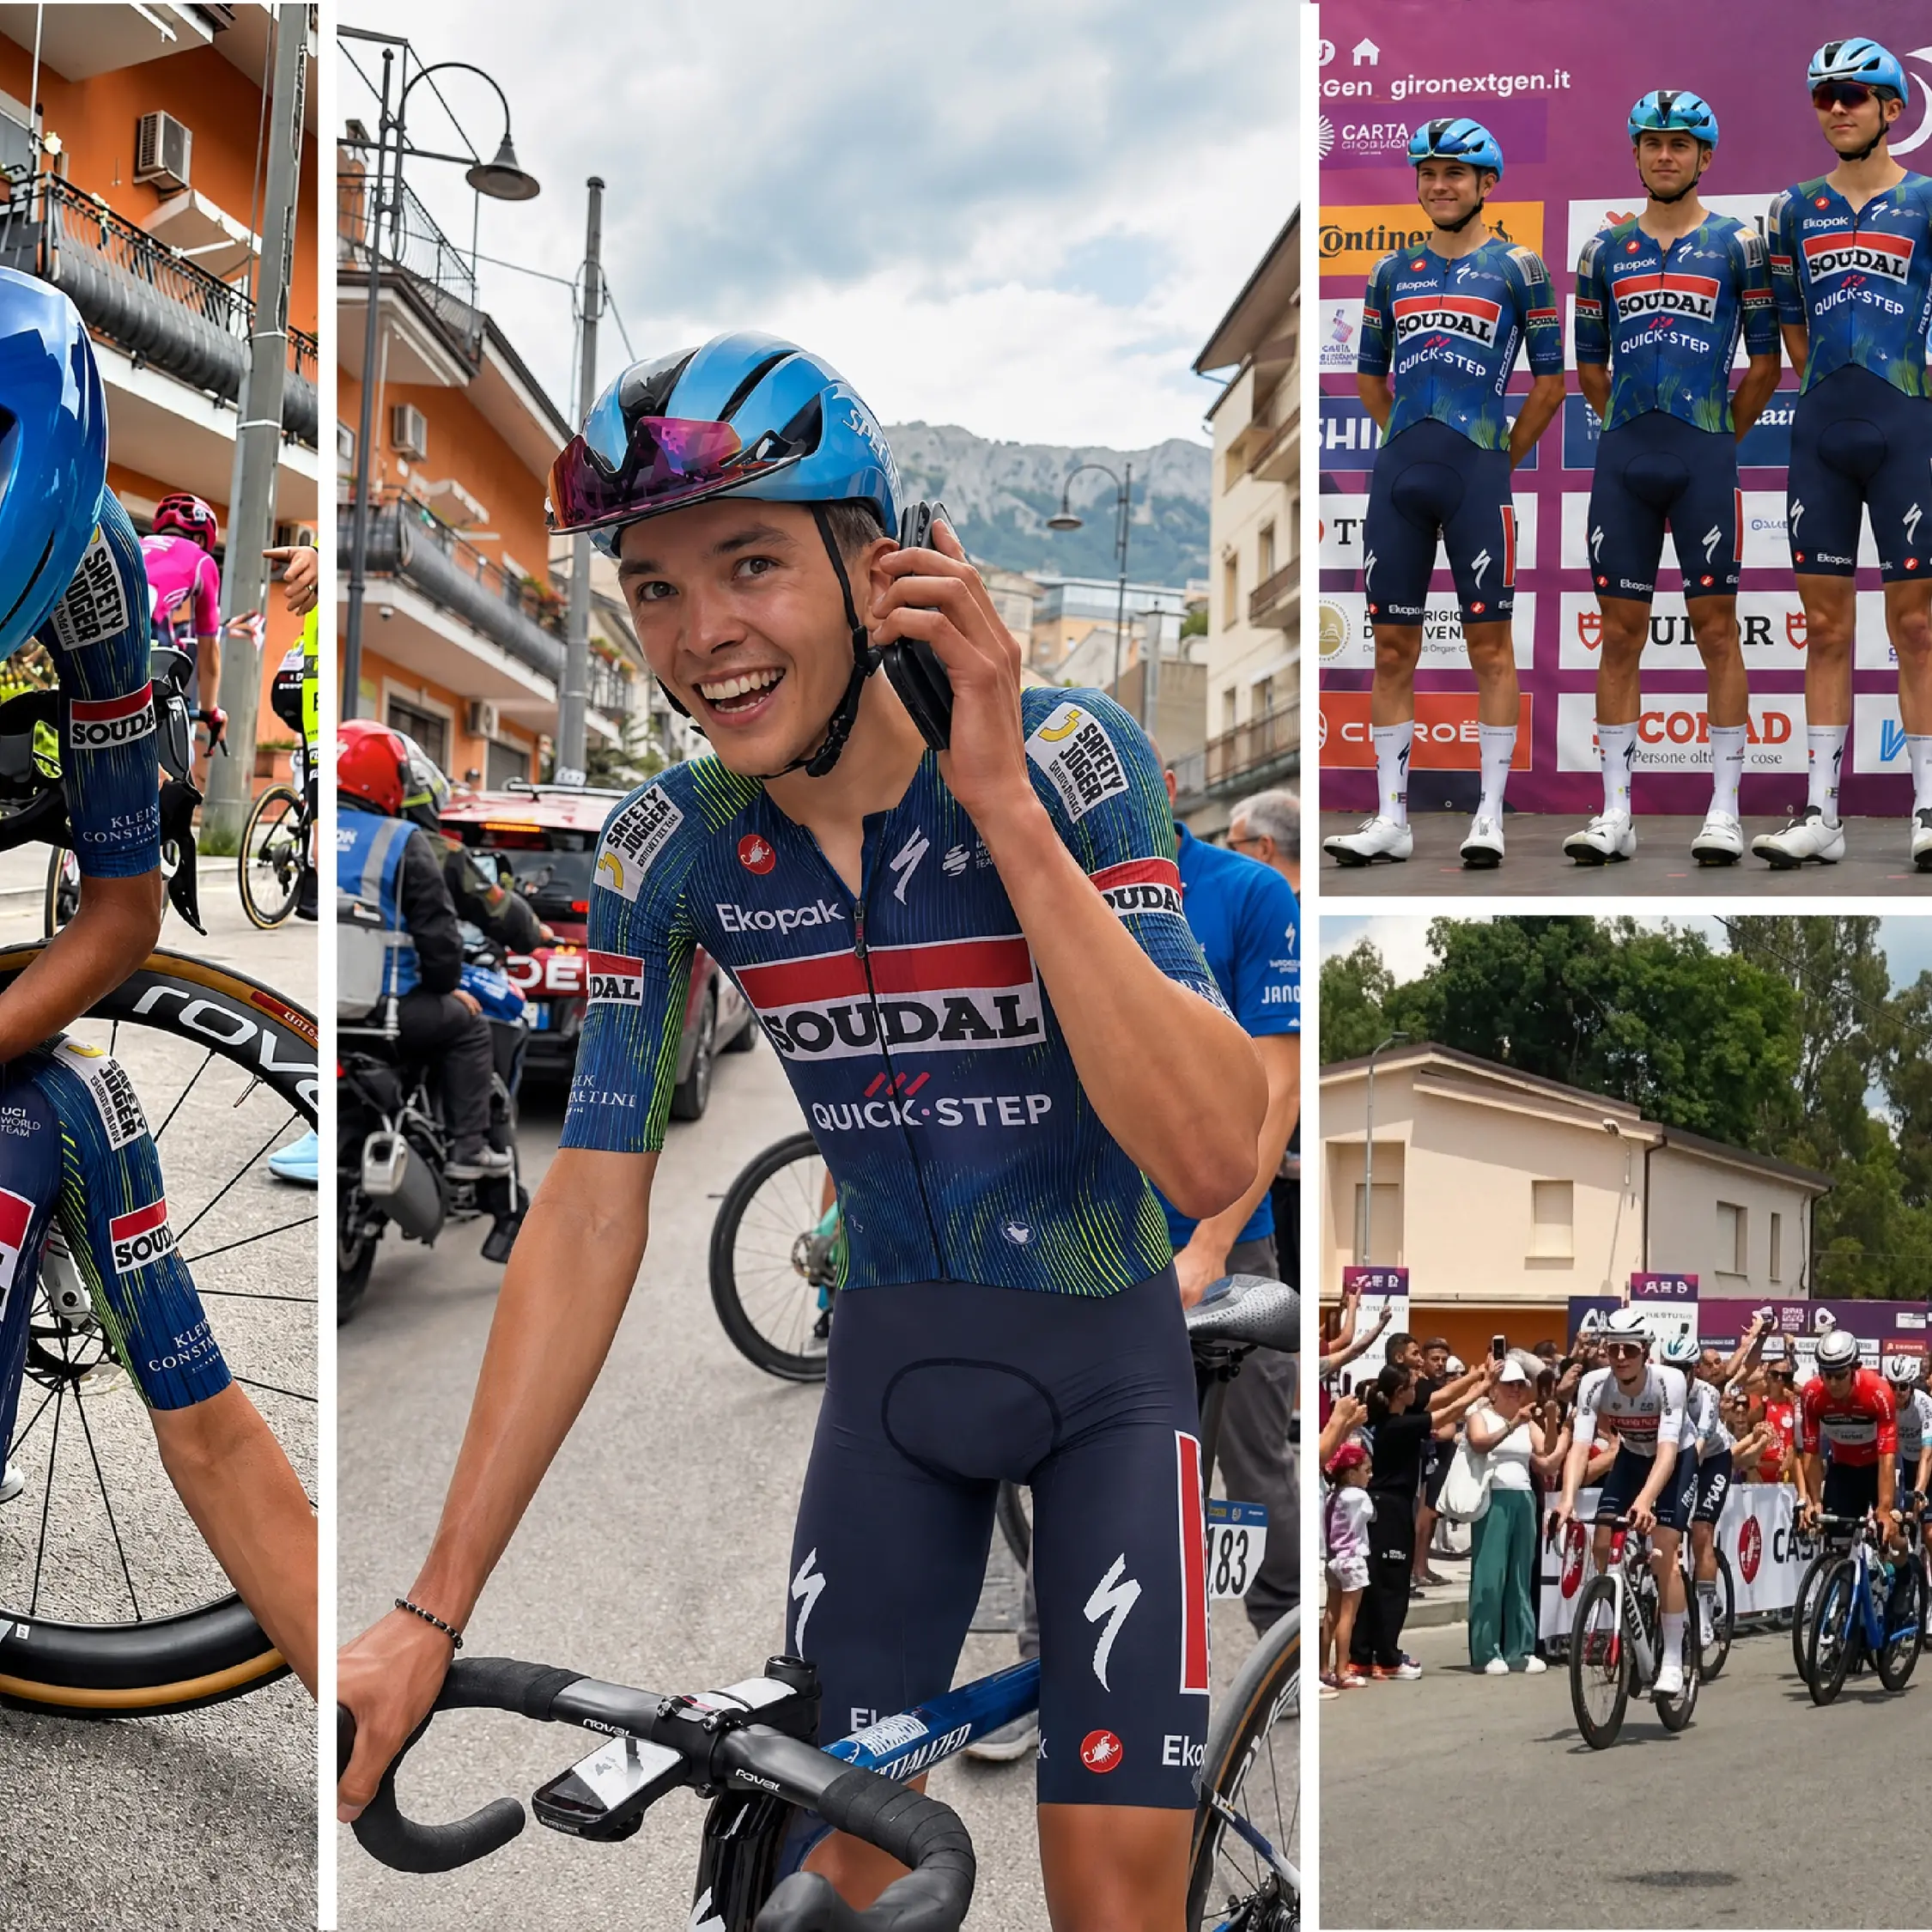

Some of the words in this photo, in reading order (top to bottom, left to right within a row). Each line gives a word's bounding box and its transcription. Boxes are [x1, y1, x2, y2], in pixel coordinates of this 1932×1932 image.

[1390, 69, 1571, 100] gironextgen.it
[1341, 123, 1409, 141] CARTA
[1808, 249, 1906, 277] SOUDAL
[1619, 291, 1713, 319] SOUDAL
[1814, 287, 1905, 316] QUICK-STEP
[1397, 311, 1492, 343] SOUDAL
[1620, 328, 1710, 354] QUICK-STEP
[1399, 347, 1487, 376] QUICK-STEP
[84, 546, 125, 631] SAFETY
[1341, 720, 1480, 743] CIROË
[1075, 721, 1124, 791] SAFETY
[1632, 749, 1686, 764] Persone
[1751, 752, 1783, 763] cose
[605, 787, 659, 849] SAFETY
[622, 799, 671, 860] JOGGER
[715, 897, 846, 935] Ekopak
[762, 994, 1041, 1054] SOUDAL
[1, 1116, 41, 1131] WORLD
[2, 1107, 27, 1118] UCI
[1162, 1735, 1208, 1767] Eko
